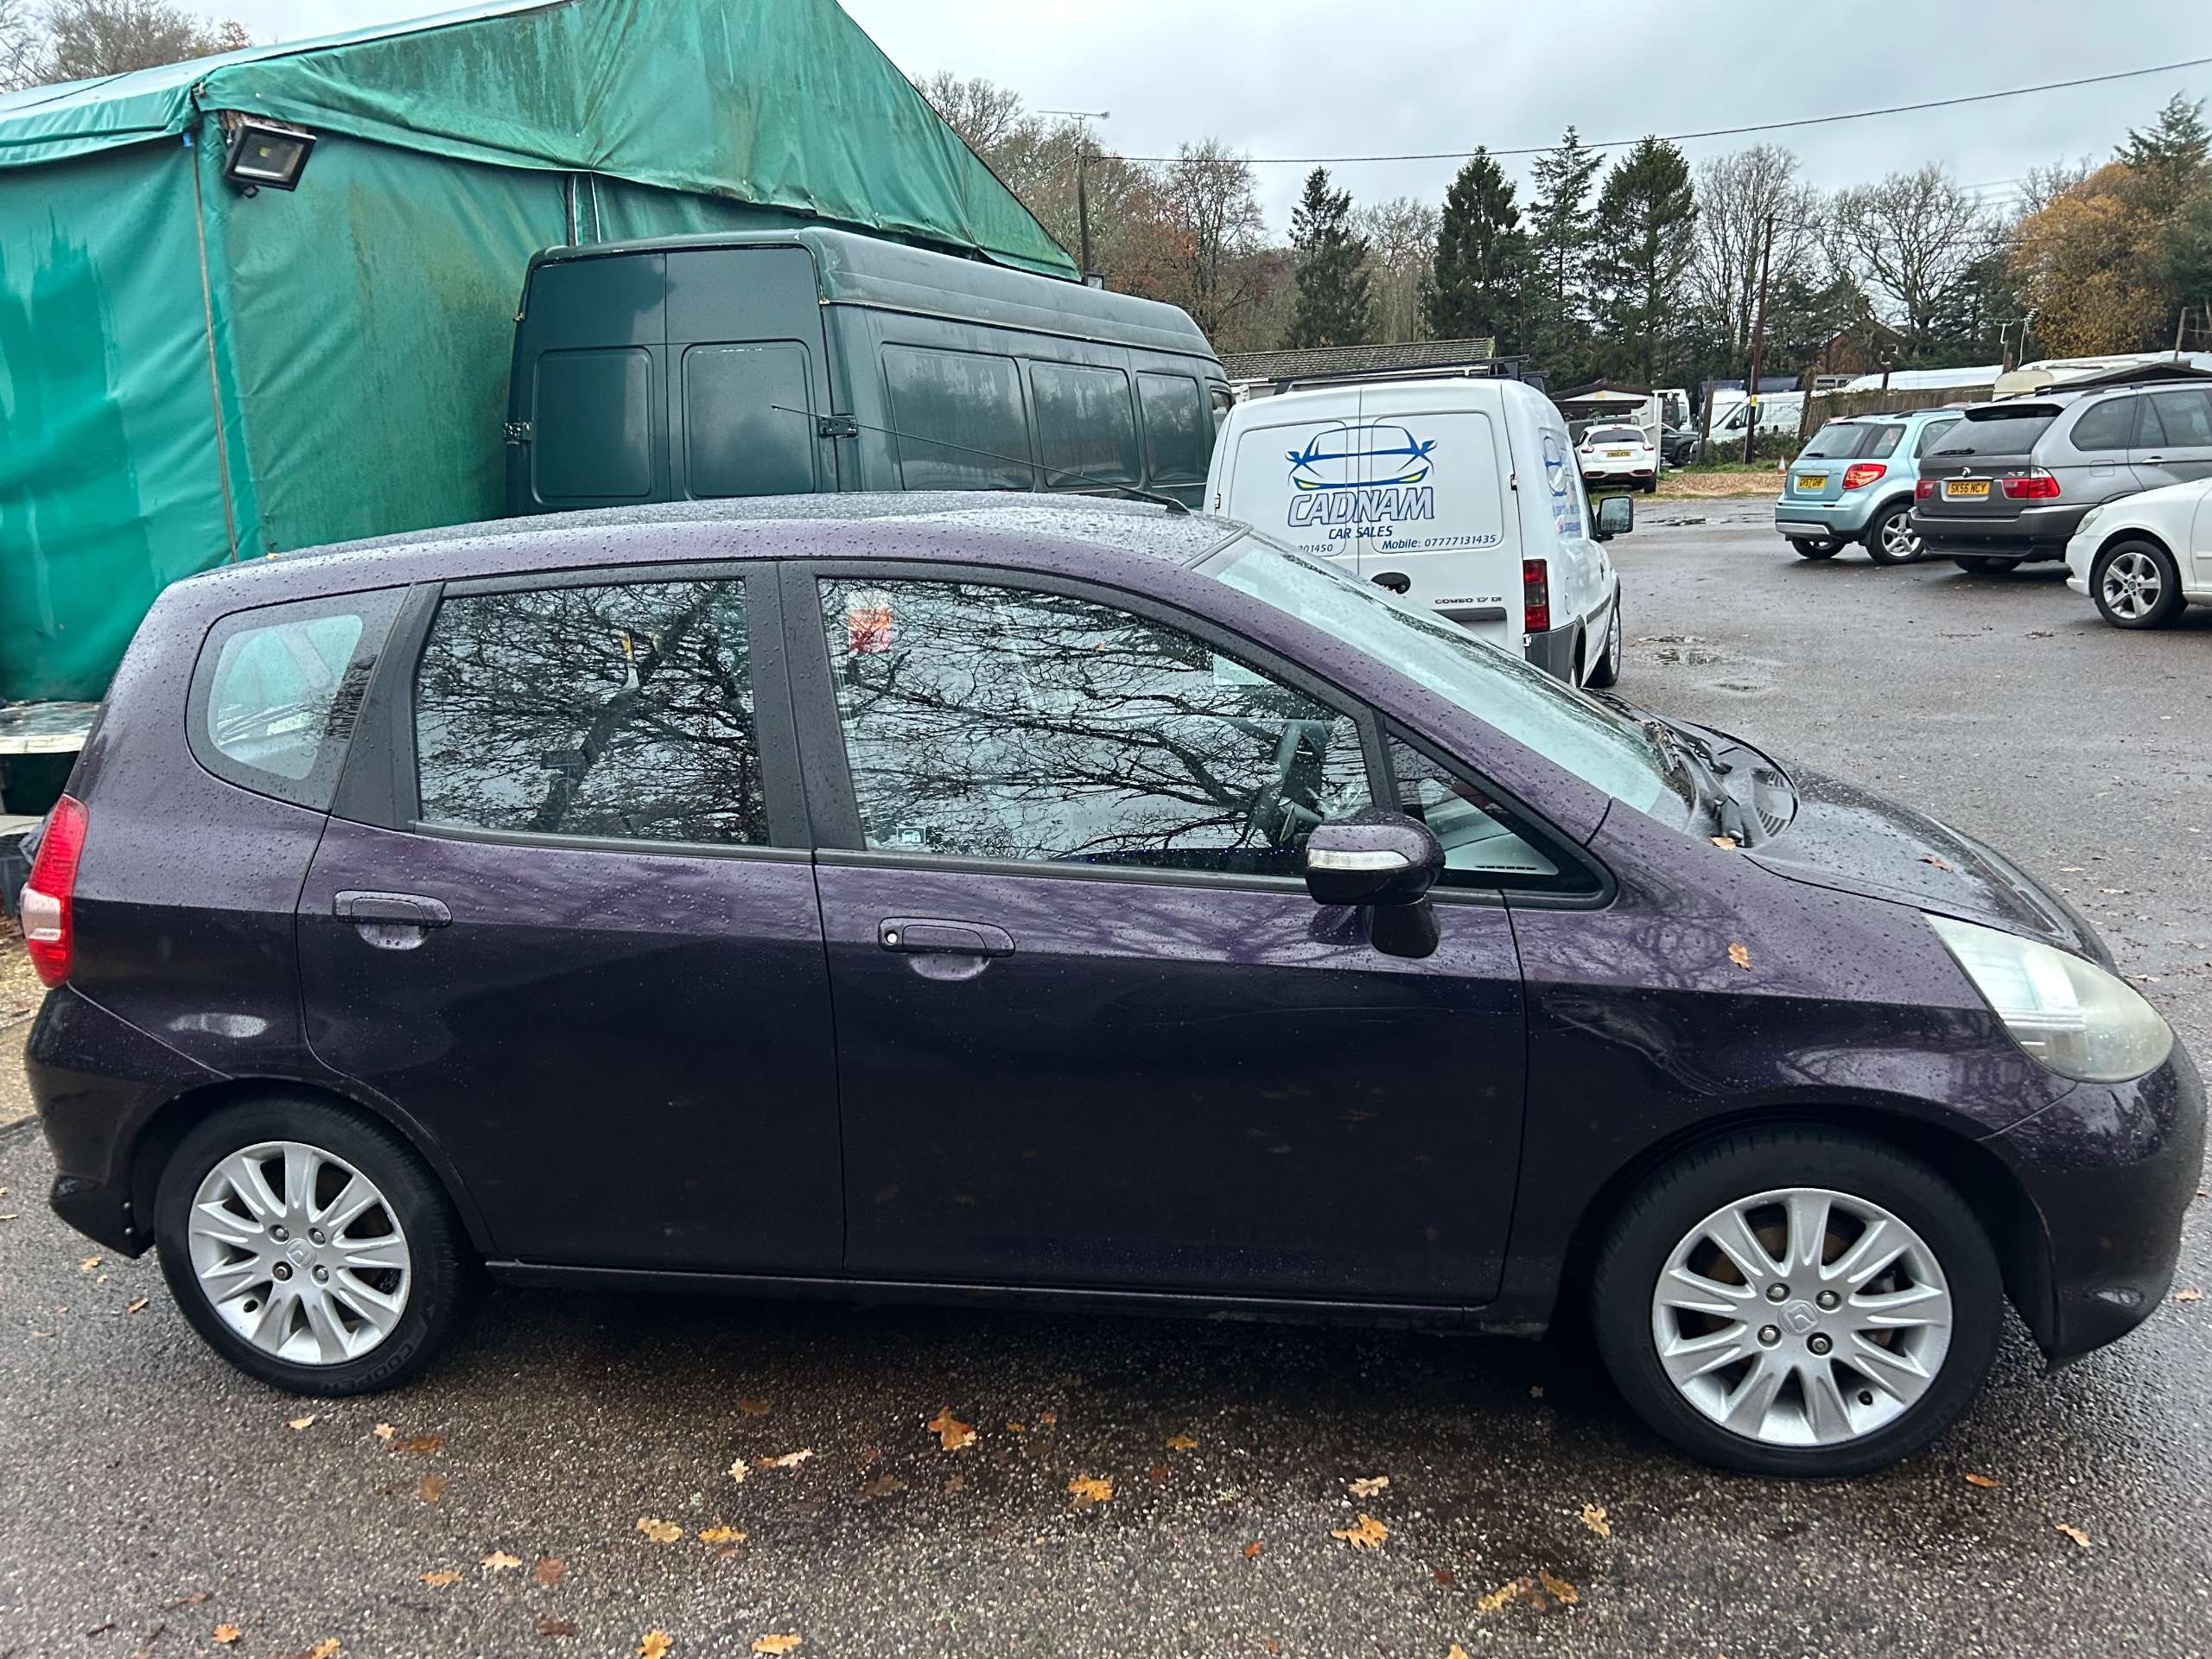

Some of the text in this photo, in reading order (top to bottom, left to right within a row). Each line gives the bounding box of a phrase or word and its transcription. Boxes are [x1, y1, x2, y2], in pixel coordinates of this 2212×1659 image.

[1950, 482, 1987, 493] SK56 NCY
[1287, 486, 1434, 527] CADNAM
[1328, 525, 1394, 540] CAR SALES
[1382, 534, 1497, 550] Mobile: 07777131435
